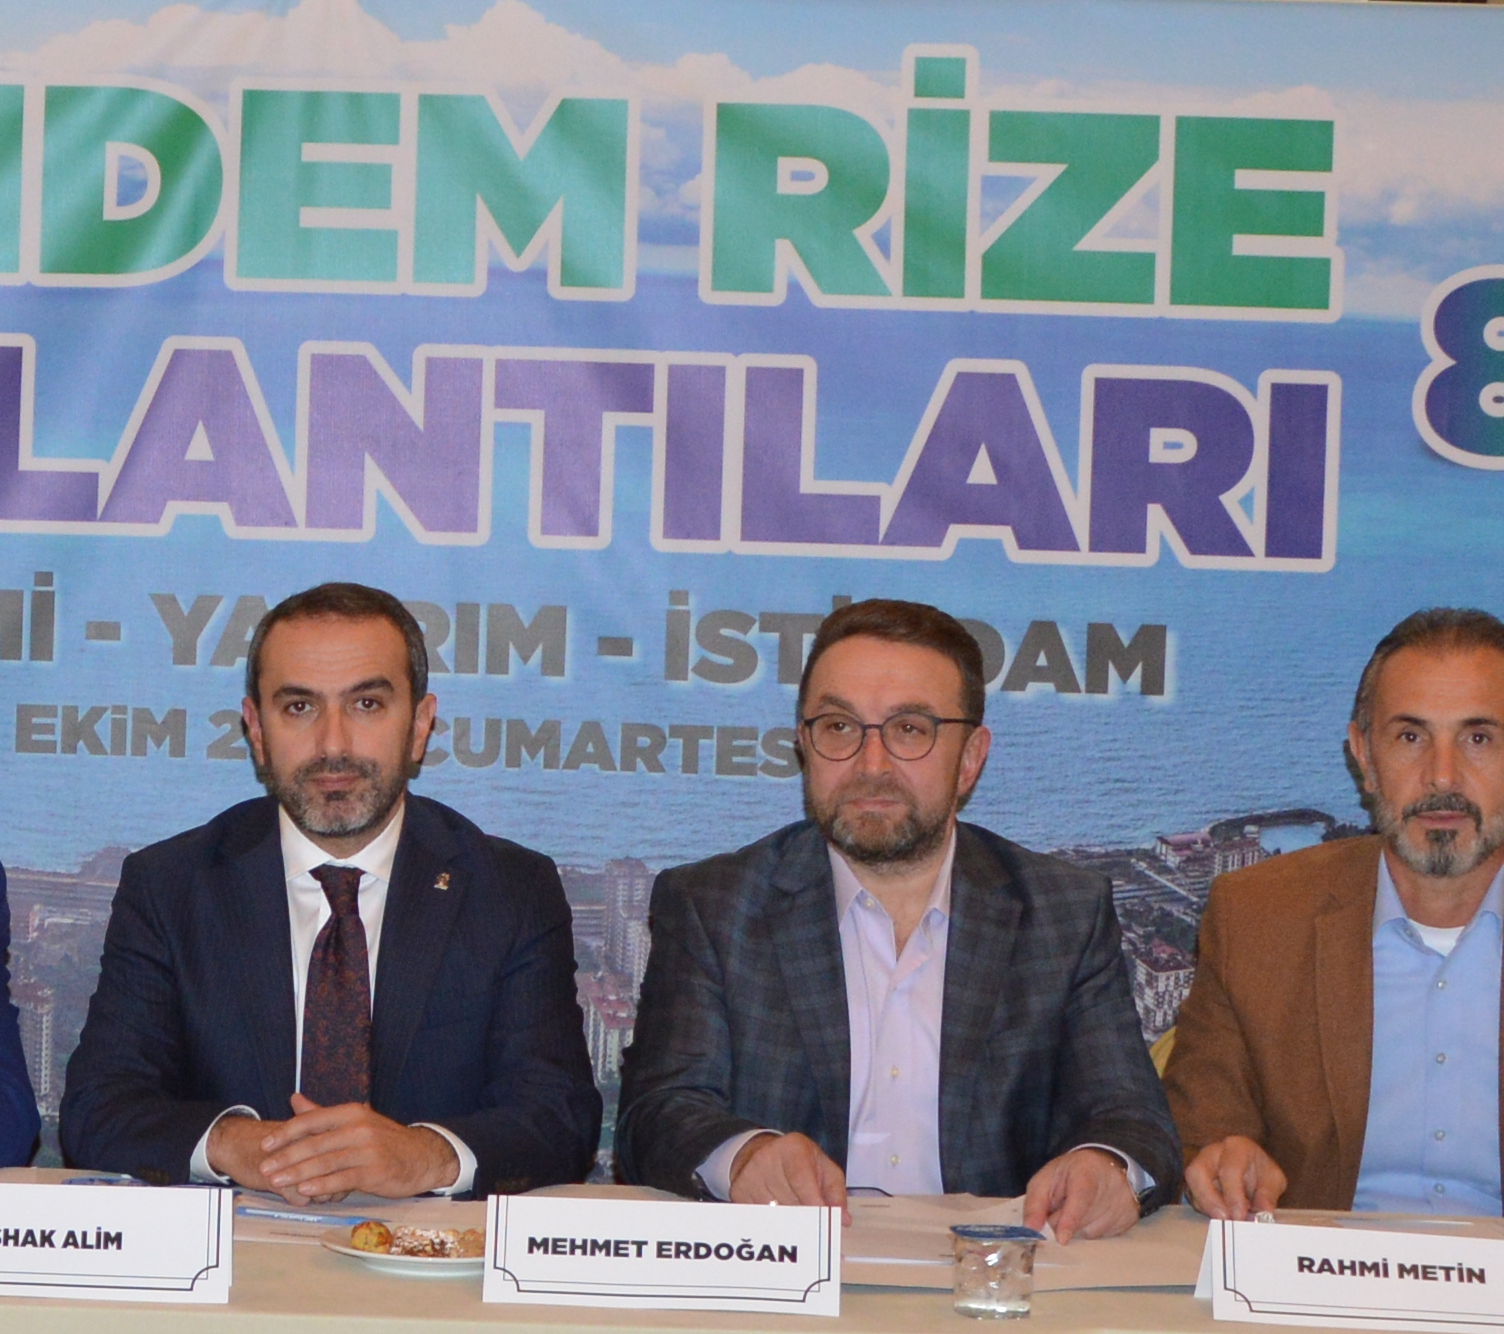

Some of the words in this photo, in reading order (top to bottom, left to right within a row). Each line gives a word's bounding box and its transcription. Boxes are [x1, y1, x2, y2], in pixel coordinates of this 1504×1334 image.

[709, 55, 1336, 311] RİZE
[148, 592, 568, 678] YARIM
[14, 703, 187, 758] EKİM
[60, 1226, 123, 1251] ALİM
[526, 1236, 649, 1259] MEHMET
[655, 1238, 799, 1264] ERDOĞAN
[1296, 1255, 1390, 1279] RAHMİ
[1396, 1262, 1487, 1285] METİN
